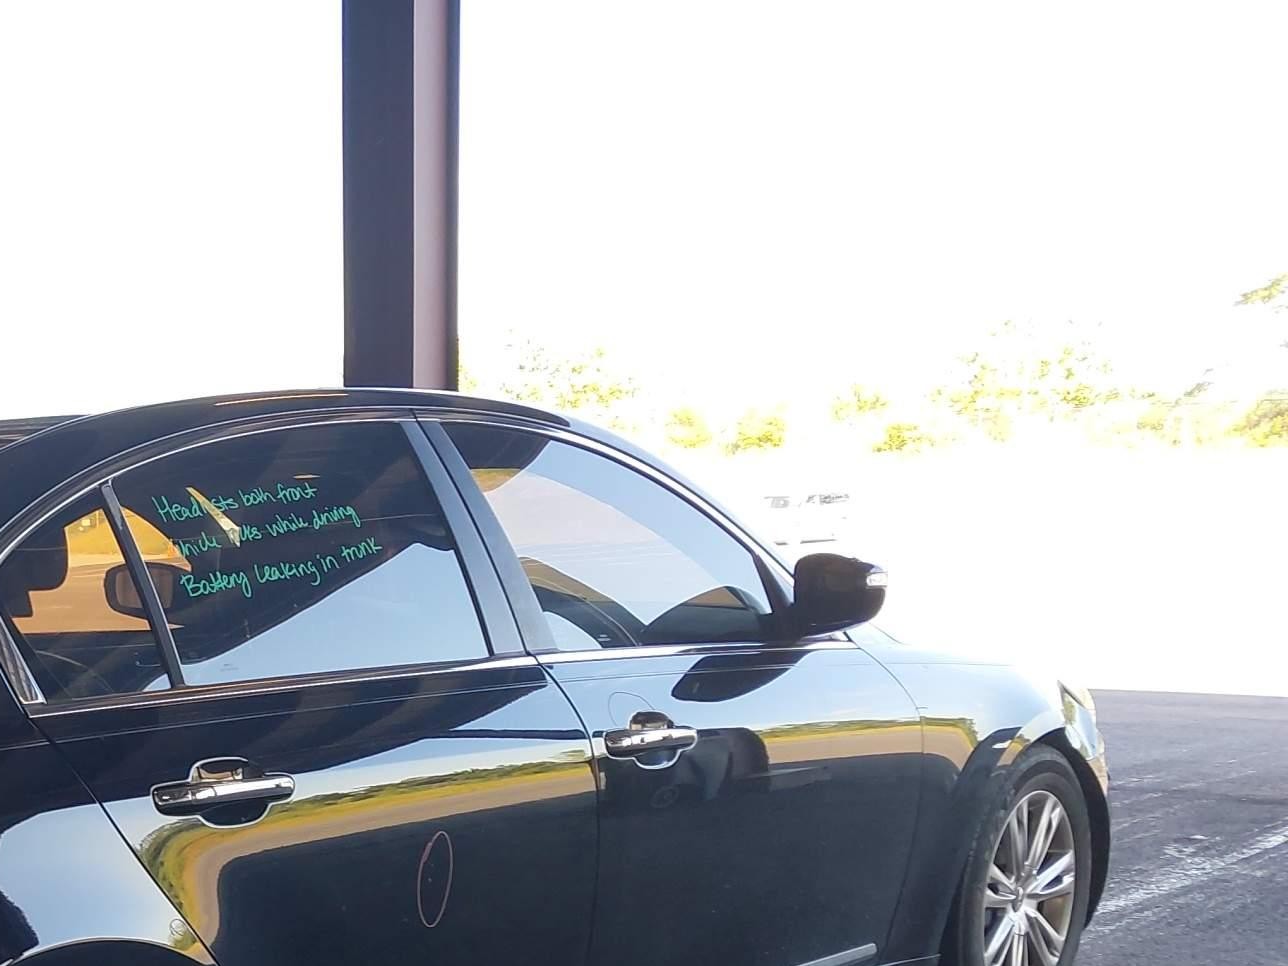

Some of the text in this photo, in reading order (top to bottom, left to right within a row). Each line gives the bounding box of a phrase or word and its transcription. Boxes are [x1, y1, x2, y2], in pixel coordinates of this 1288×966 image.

[238, 487, 276, 507] both
[276, 482, 318, 504] front
[265, 512, 309, 537] while
[313, 505, 361, 530] driving
[180, 571, 252, 598] Battery
[316, 554, 341, 573] in
[341, 536, 383, 563] trunk
